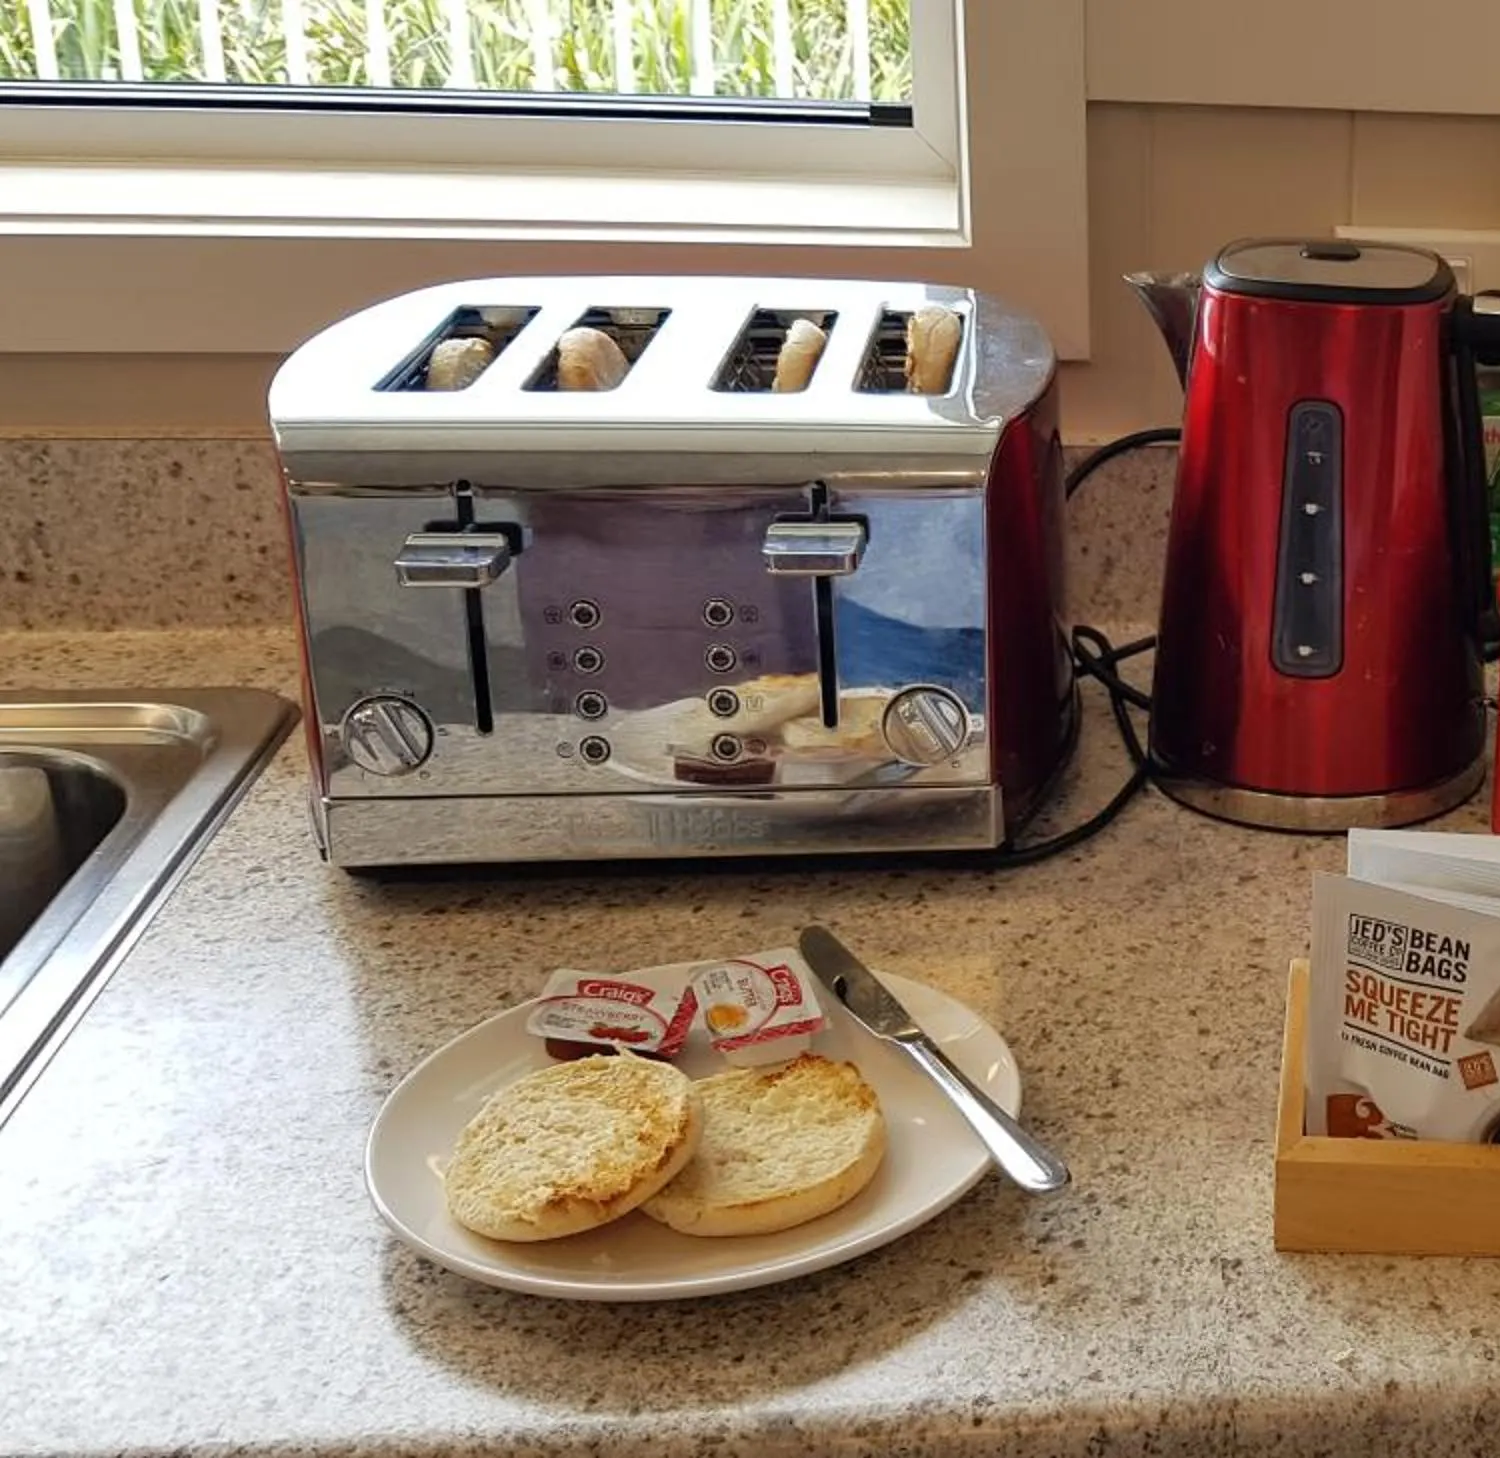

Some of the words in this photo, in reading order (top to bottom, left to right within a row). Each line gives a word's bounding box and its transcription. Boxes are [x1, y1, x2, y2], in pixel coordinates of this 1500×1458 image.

[1352, 918, 1405, 947] JED'S
[1410, 928, 1471, 960] BEAN
[1405, 951, 1468, 983] BAGS
[1345, 969, 1462, 1027] SQUEEZE
[1344, 994, 1379, 1026] ME
[1386, 1008, 1457, 1054] TIGHT
[1409, 1056, 1431, 1073] BEAN
